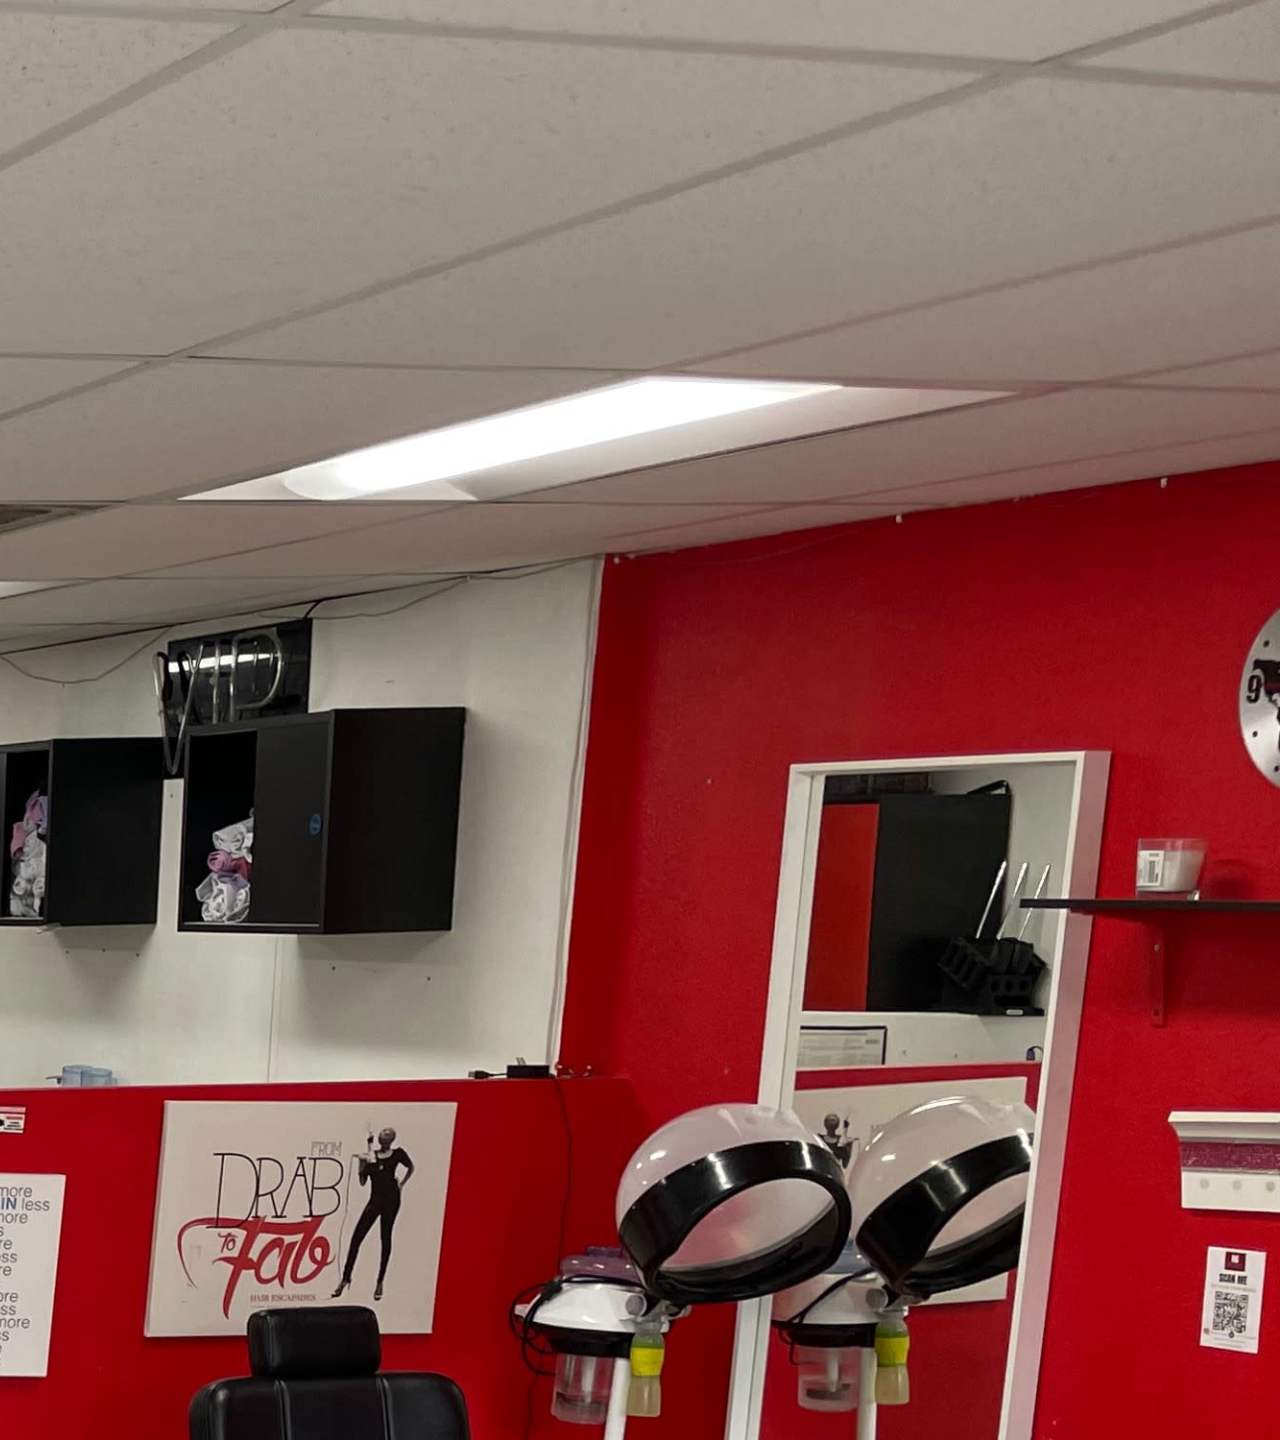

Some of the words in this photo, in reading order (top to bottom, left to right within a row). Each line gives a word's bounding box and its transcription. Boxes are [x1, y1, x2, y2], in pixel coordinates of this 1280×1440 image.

[1246, 674, 1263, 704] 9
[310, 1141, 342, 1156] FROM
[22, 1198, 50, 1211] less
[206, 1153, 344, 1229] DRAB
[177, 1216, 335, 1320] Fab
